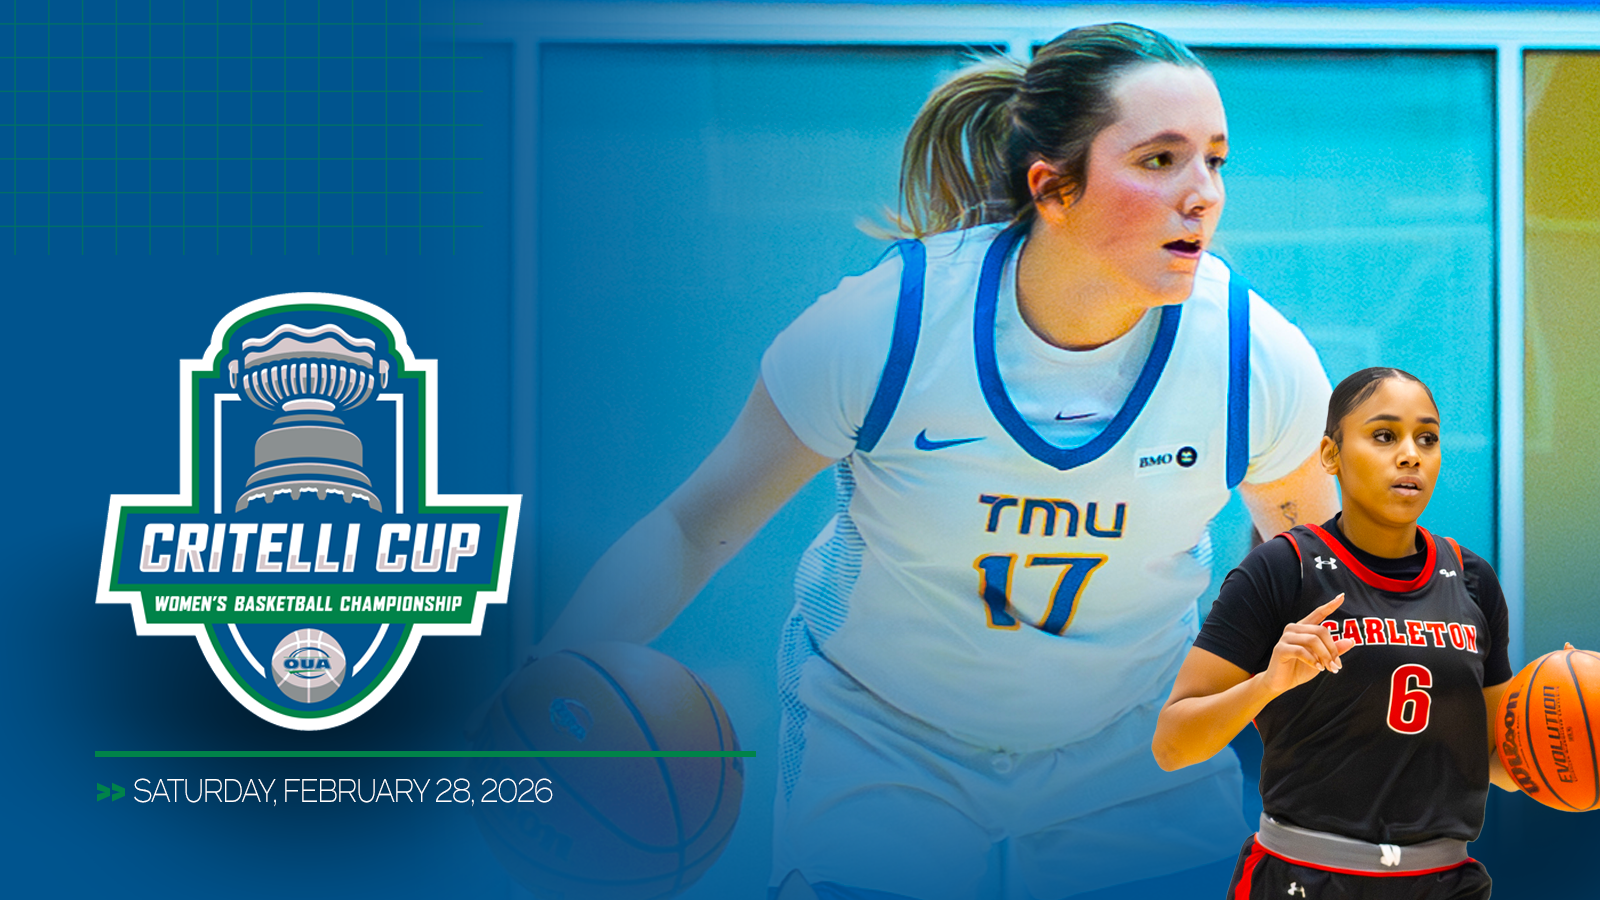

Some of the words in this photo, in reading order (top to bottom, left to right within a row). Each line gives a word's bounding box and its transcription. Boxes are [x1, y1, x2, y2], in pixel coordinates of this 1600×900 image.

[1138, 453, 1173, 468] BMO
[978, 493, 1128, 538] TMU
[973, 553, 1108, 637] 17
[1320, 617, 1478, 654] CARLETON
[1386, 663, 1433, 735] 6
[1543, 685, 1574, 783] EVOLUTION
